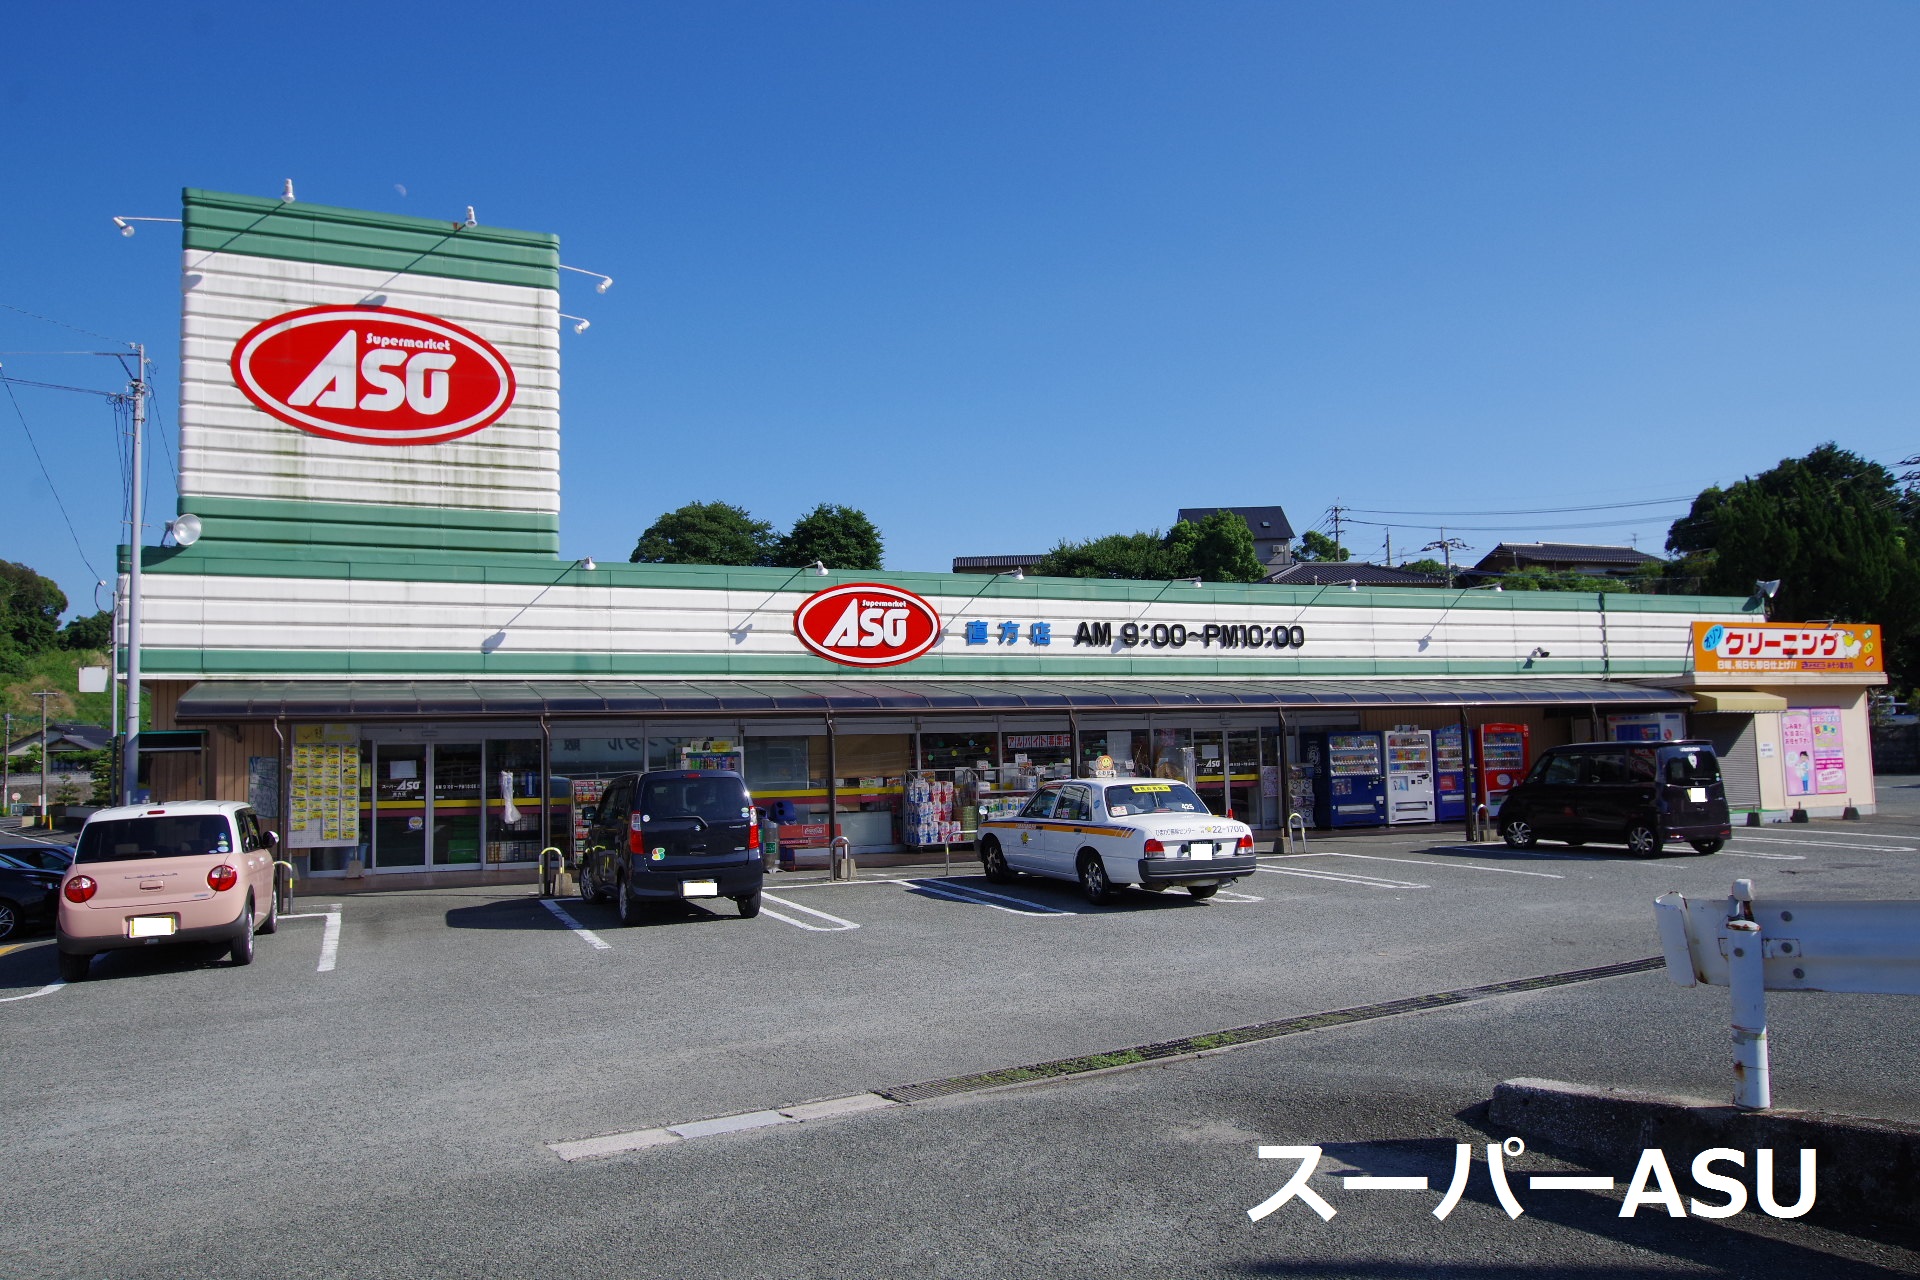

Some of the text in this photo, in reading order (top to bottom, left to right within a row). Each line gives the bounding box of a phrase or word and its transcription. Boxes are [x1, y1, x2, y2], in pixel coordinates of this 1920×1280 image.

[366, 332, 451, 351] Supermarket
[862, 599, 907, 608] Supermarket
[966, 620, 1051, 645] 直方店
[1076, 622, 1112, 646] AM
[1726, 632, 1839, 656] クリーニング
[1212, 825, 1245, 834] 22-1700
